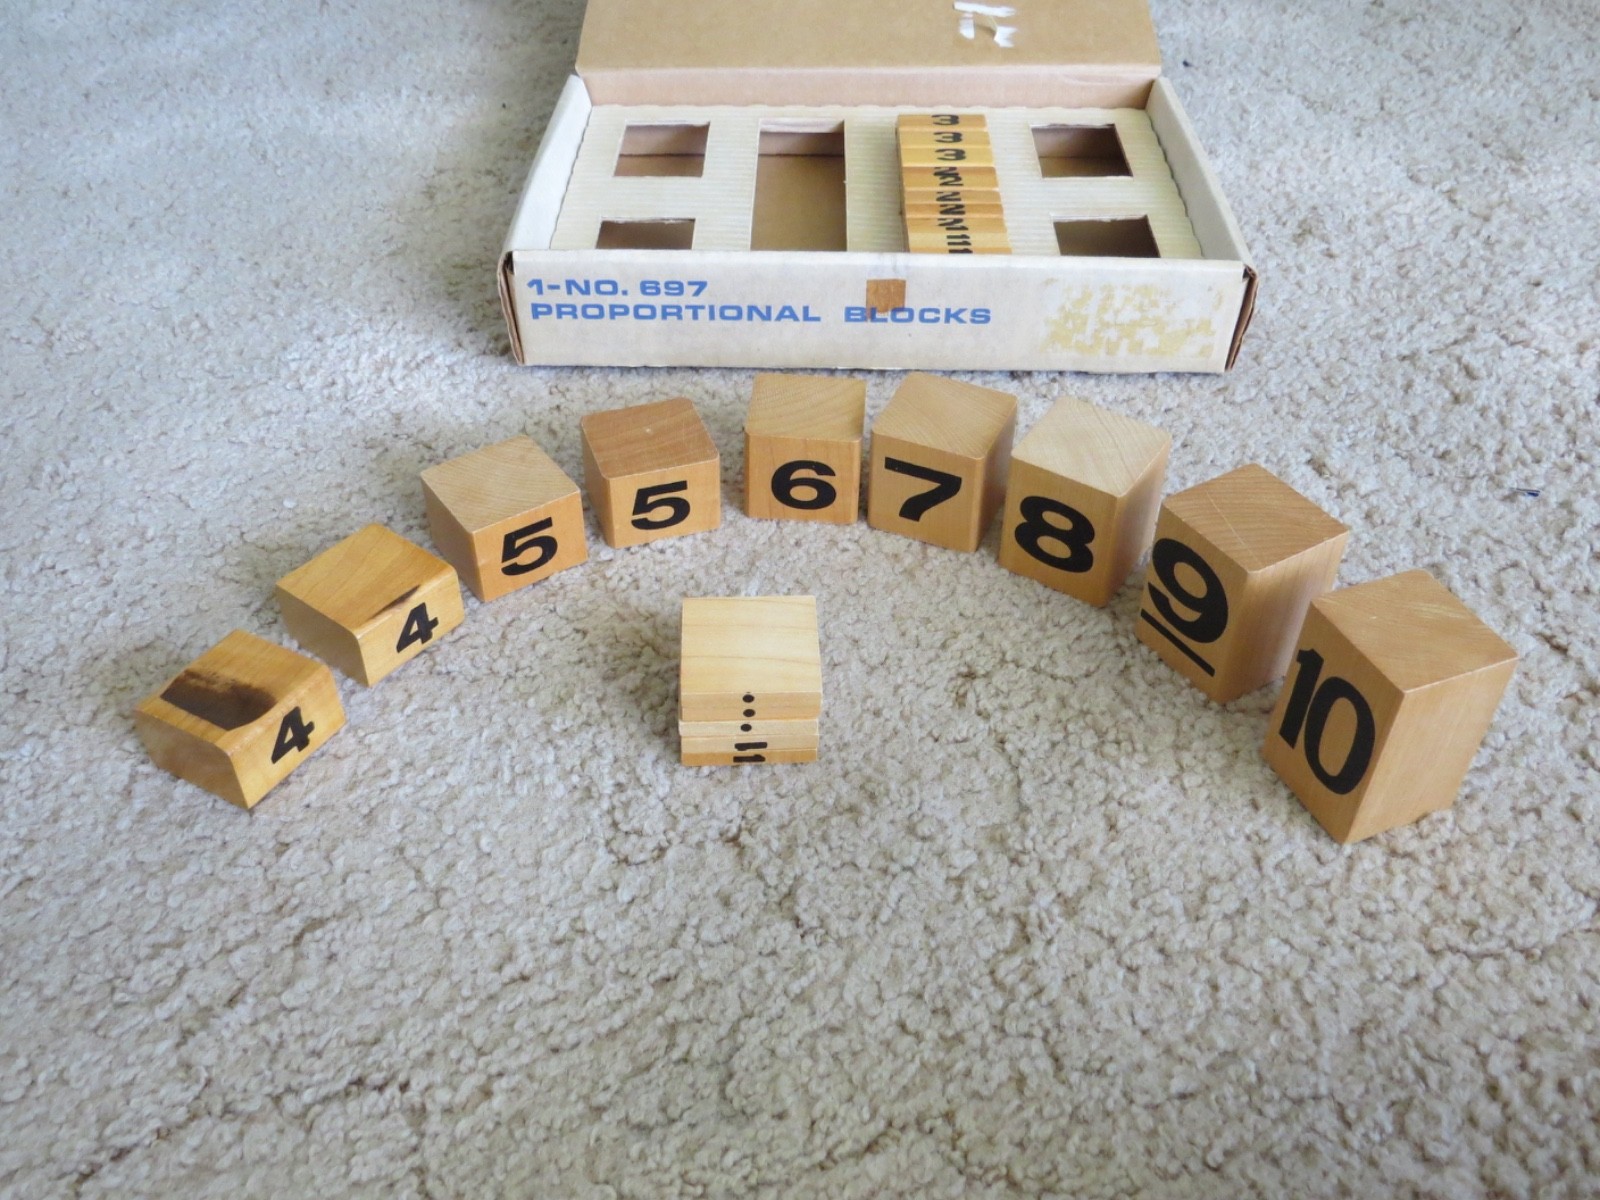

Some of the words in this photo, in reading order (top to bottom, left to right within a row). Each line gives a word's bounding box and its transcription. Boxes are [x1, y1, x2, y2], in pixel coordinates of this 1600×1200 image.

[931, 114, 960, 126] 3
[933, 131, 963, 144] 3
[935, 148, 967, 161] 3
[939, 203, 966, 215] 2
[527, 278, 629, 298] 1-NO.
[638, 279, 710, 298] 697
[531, 302, 822, 323] PROPORTIONAL
[843, 305, 993, 326] BLOCKS
[632, 480, 691, 530] 5
[771, 460, 837, 510] 6
[884, 457, 963, 522] 7
[502, 517, 558, 576] 5
[1014, 495, 1096, 574] 8
[1147, 537, 1229, 644] 9
[396, 603, 438, 653] 4
[271, 708, 314, 763] 4
[1278, 648, 1376, 795] 10
